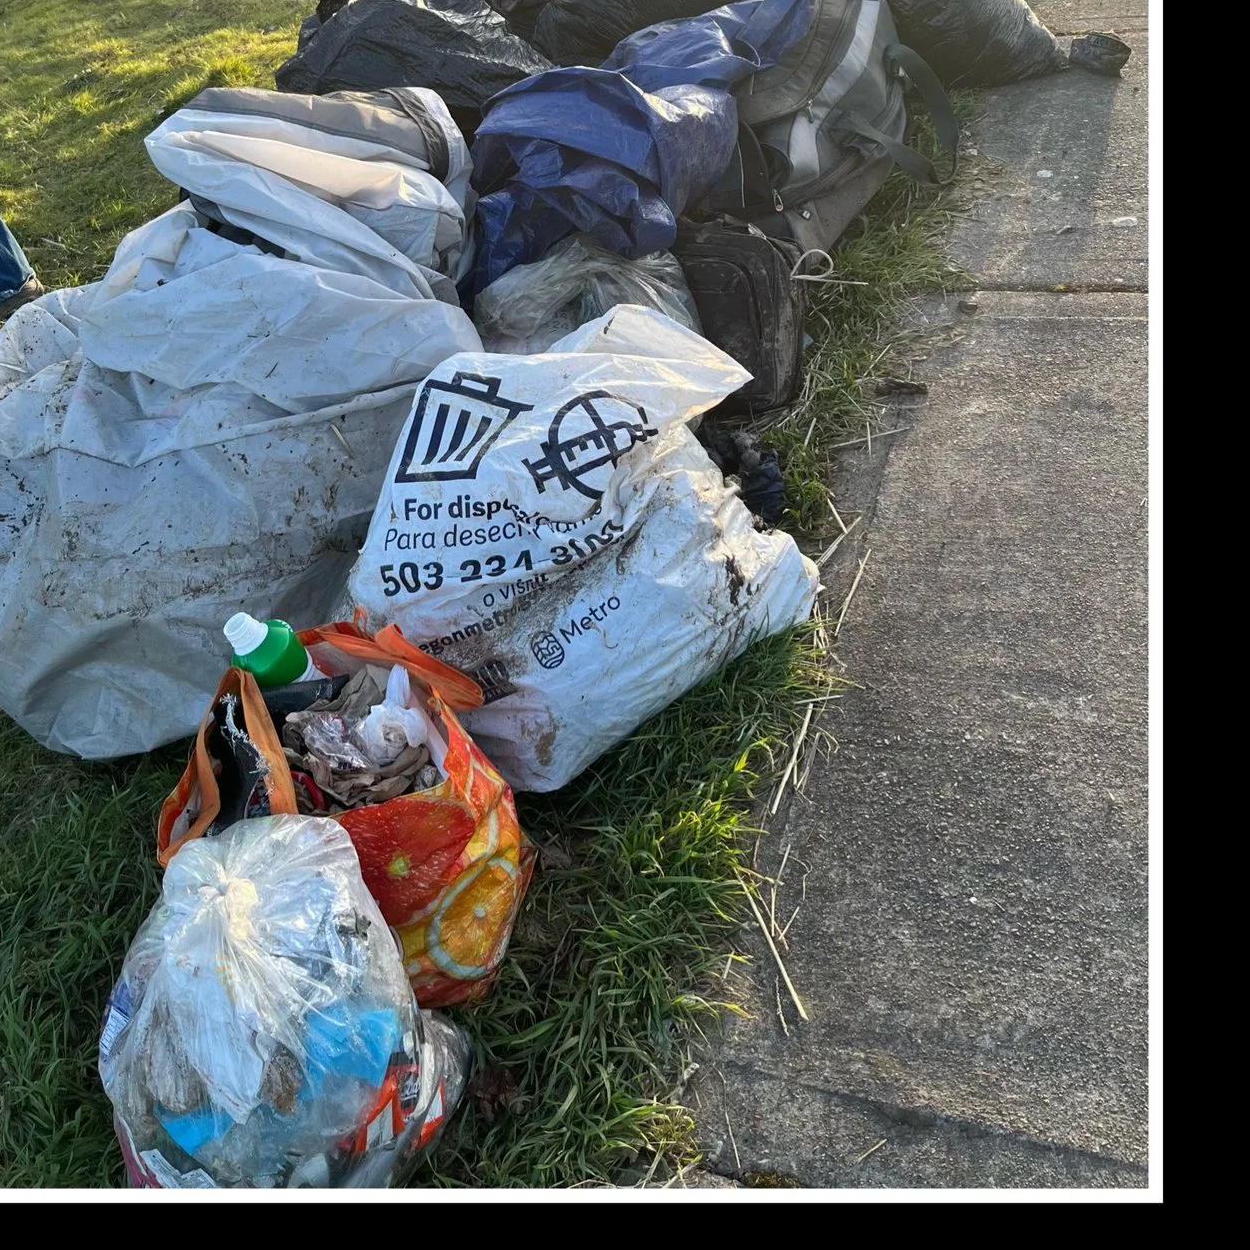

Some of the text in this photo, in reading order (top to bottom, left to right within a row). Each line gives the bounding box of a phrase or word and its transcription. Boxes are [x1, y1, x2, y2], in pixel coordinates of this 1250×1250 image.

[404, 497, 443, 522] For
[384, 528, 437, 552] Para
[558, 595, 622, 645] Metro
